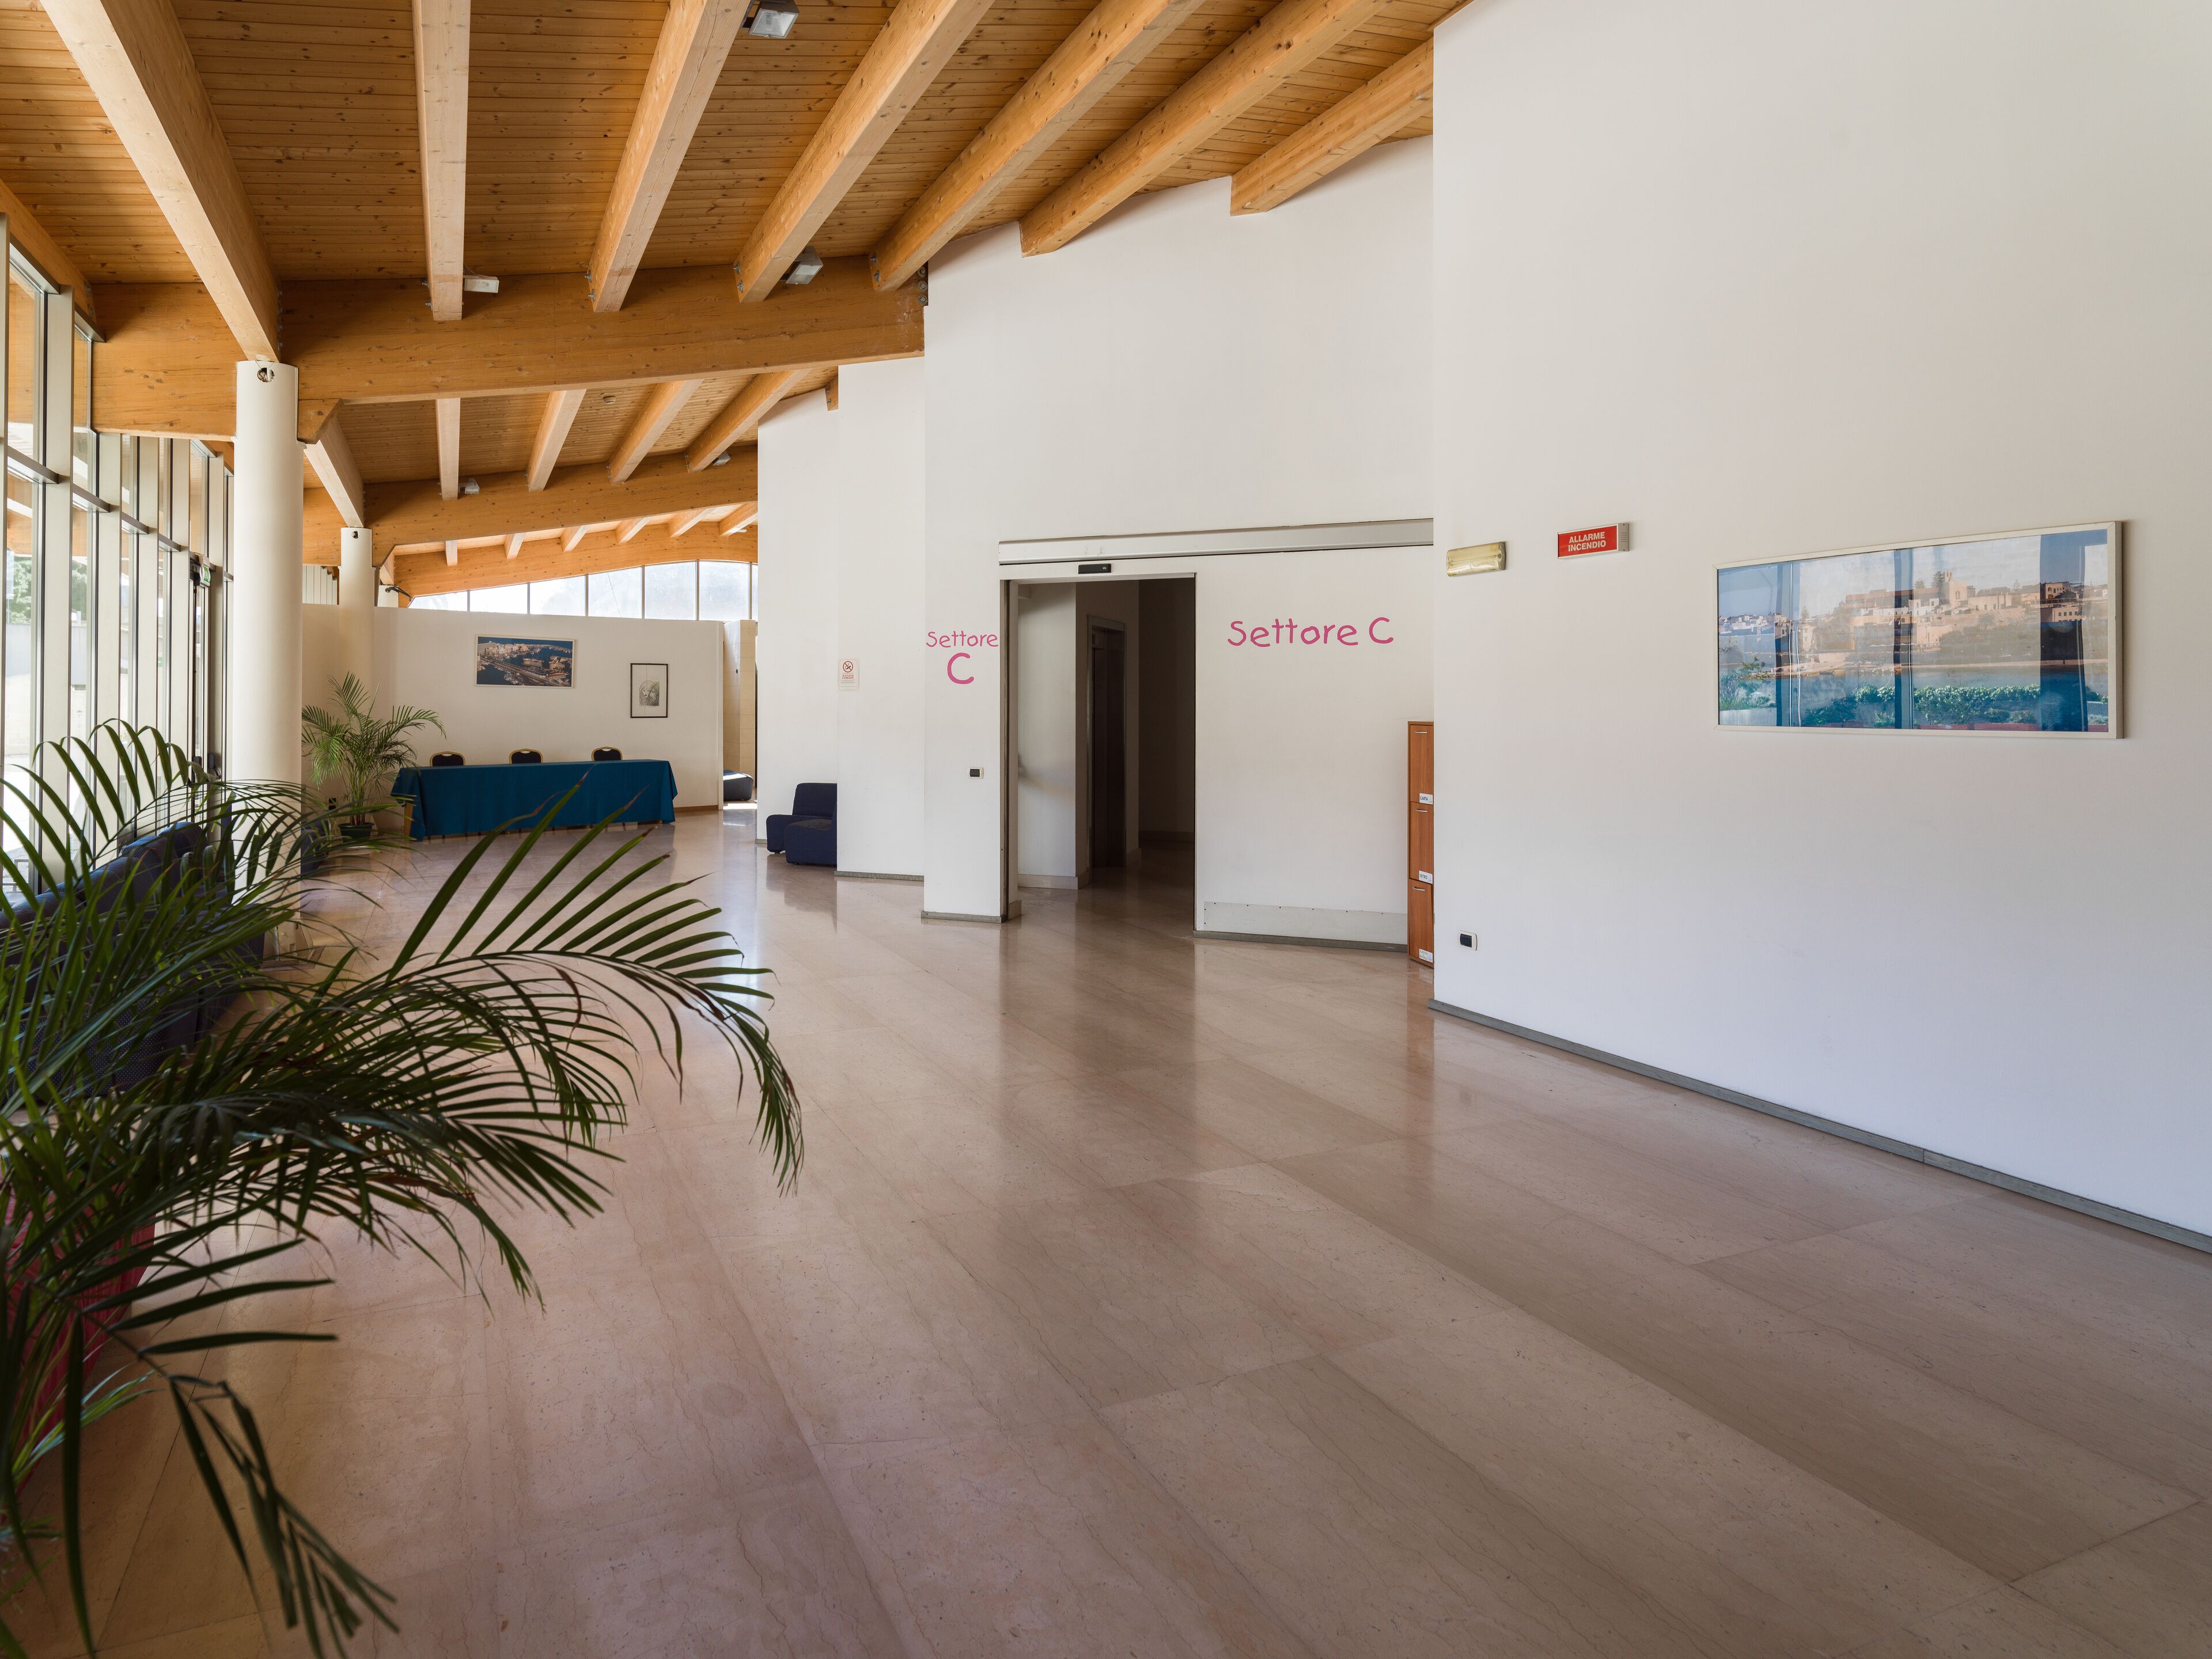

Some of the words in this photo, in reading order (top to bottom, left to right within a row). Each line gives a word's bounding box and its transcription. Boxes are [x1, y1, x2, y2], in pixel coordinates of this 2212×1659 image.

[1569, 532, 1605, 543] ALLARME
[1568, 540, 1606, 552] INCENDIO
[926, 631, 998, 647] Settore
[1228, 618, 1358, 647] Settore
[1369, 618, 1394, 644] C
[947, 653, 974, 684] C
